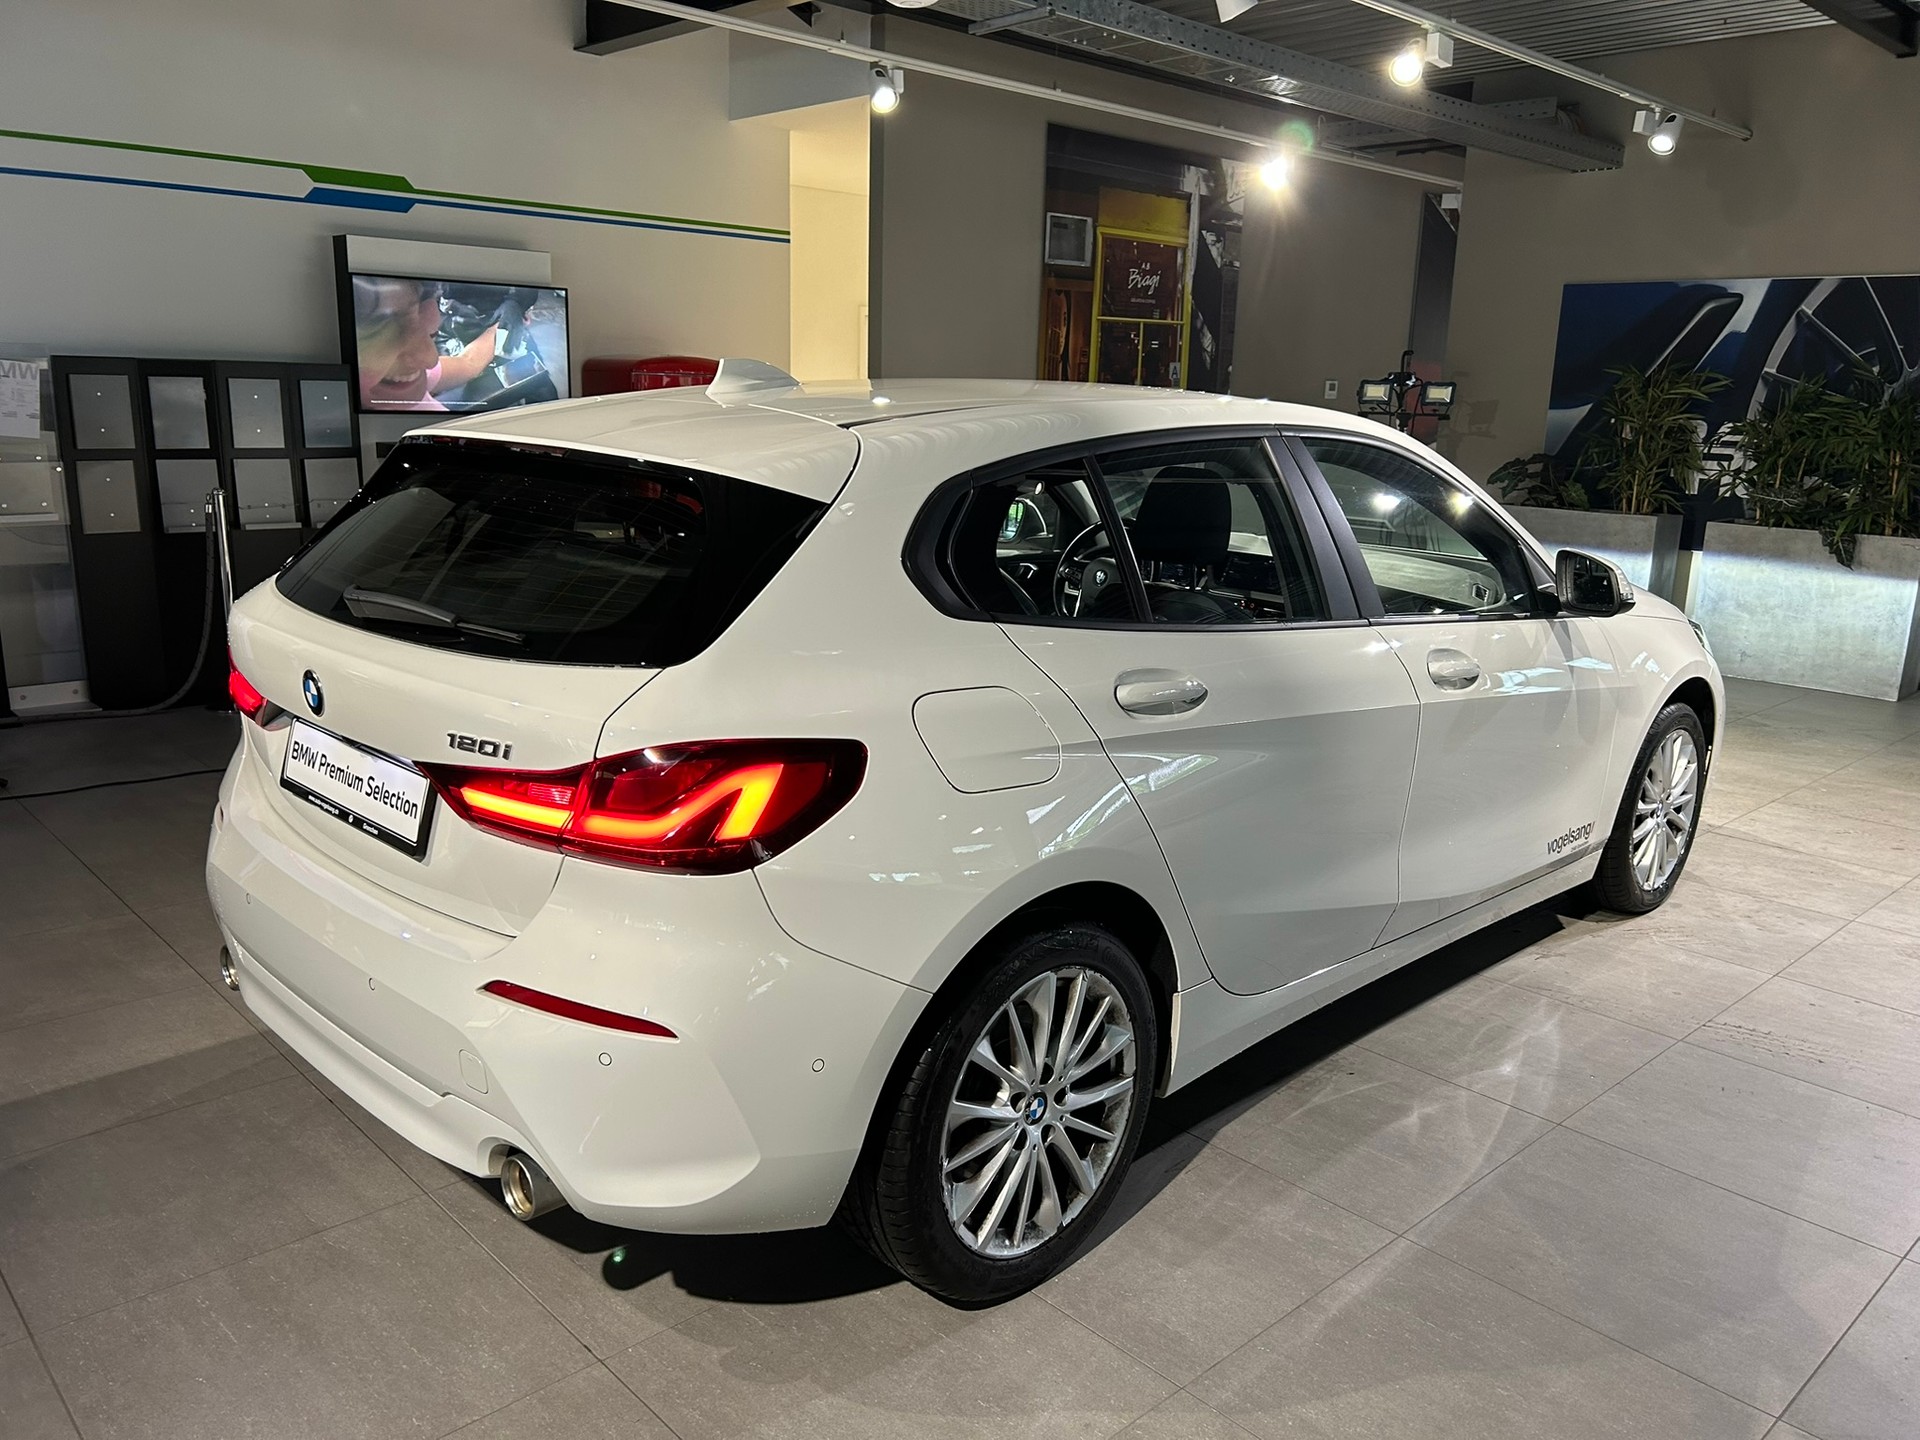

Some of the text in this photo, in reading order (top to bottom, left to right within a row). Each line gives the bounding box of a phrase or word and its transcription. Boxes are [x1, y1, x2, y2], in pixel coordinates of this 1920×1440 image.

[1128, 268, 1161, 295] Biagi
[447, 732, 513, 760] 120i
[291, 740, 319, 770] BMW
[318, 759, 363, 793] Premium
[365, 776, 418, 819] Selection
